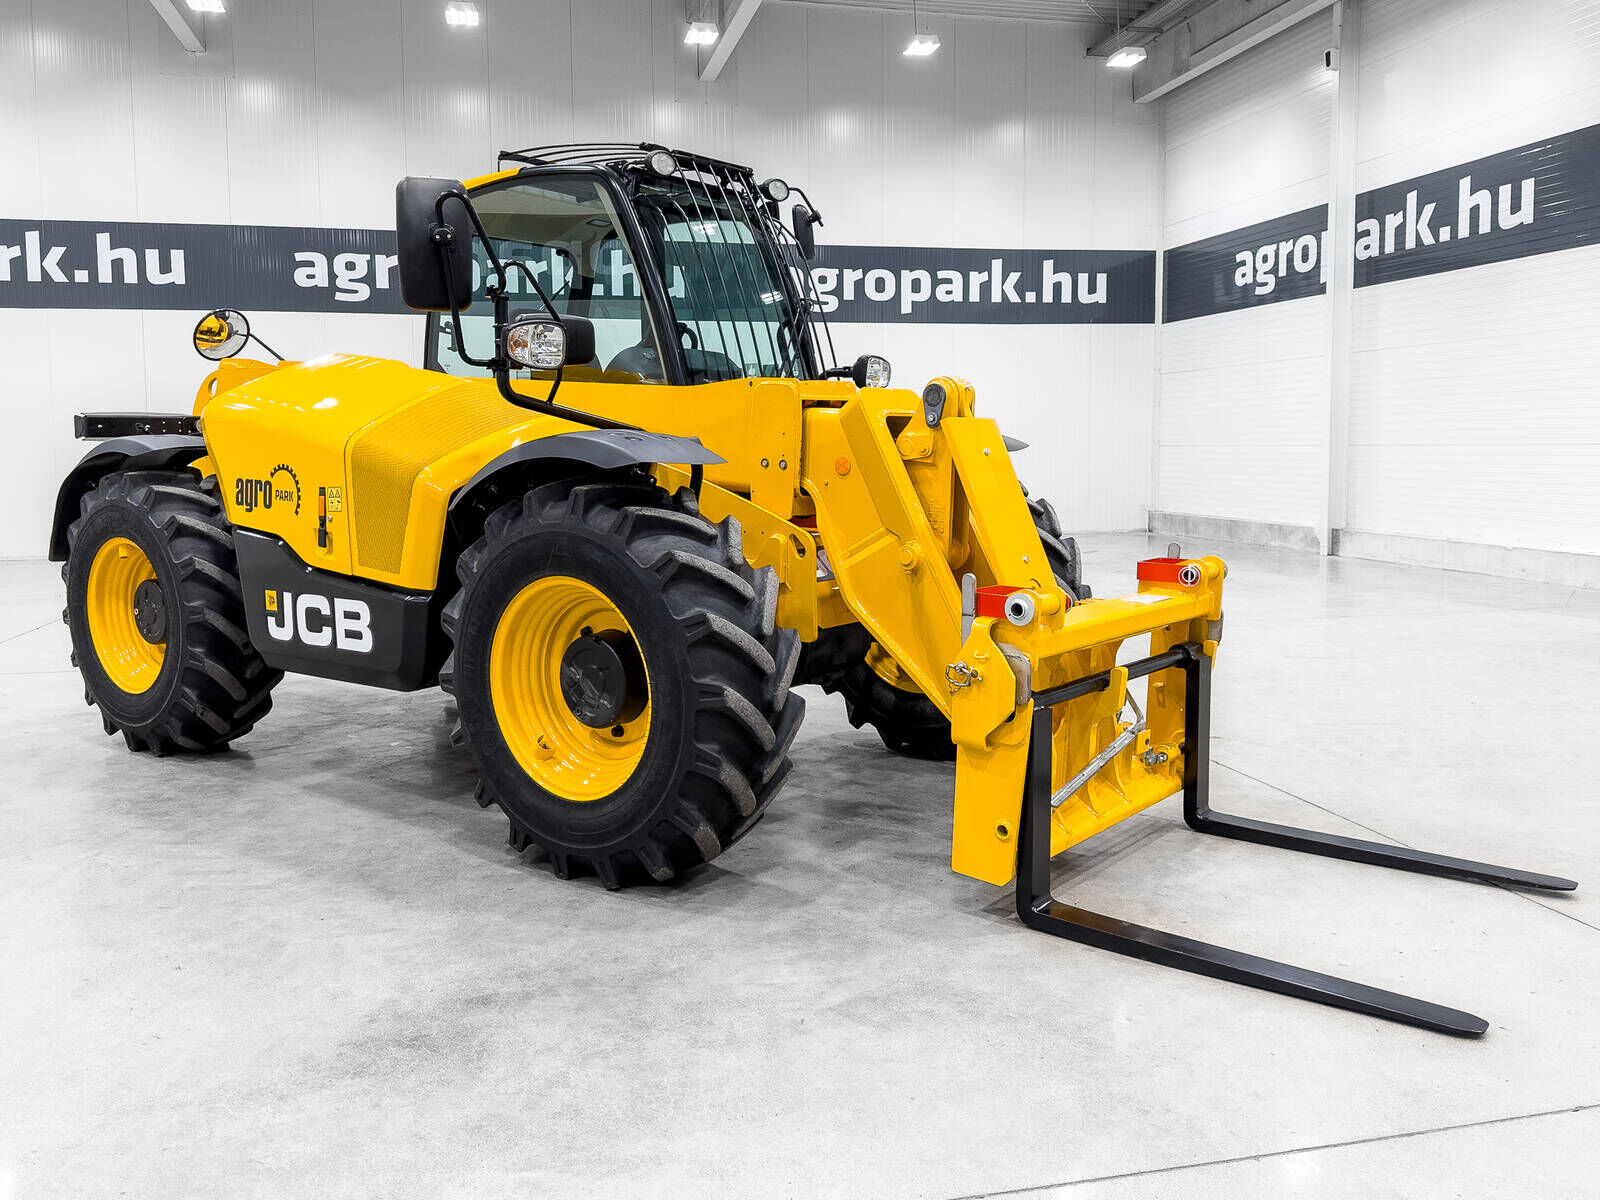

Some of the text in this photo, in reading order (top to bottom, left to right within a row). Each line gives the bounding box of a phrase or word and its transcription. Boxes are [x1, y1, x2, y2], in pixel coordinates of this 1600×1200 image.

[235, 477, 294, 513] agro PARK
[266, 591, 373, 653] JCB
